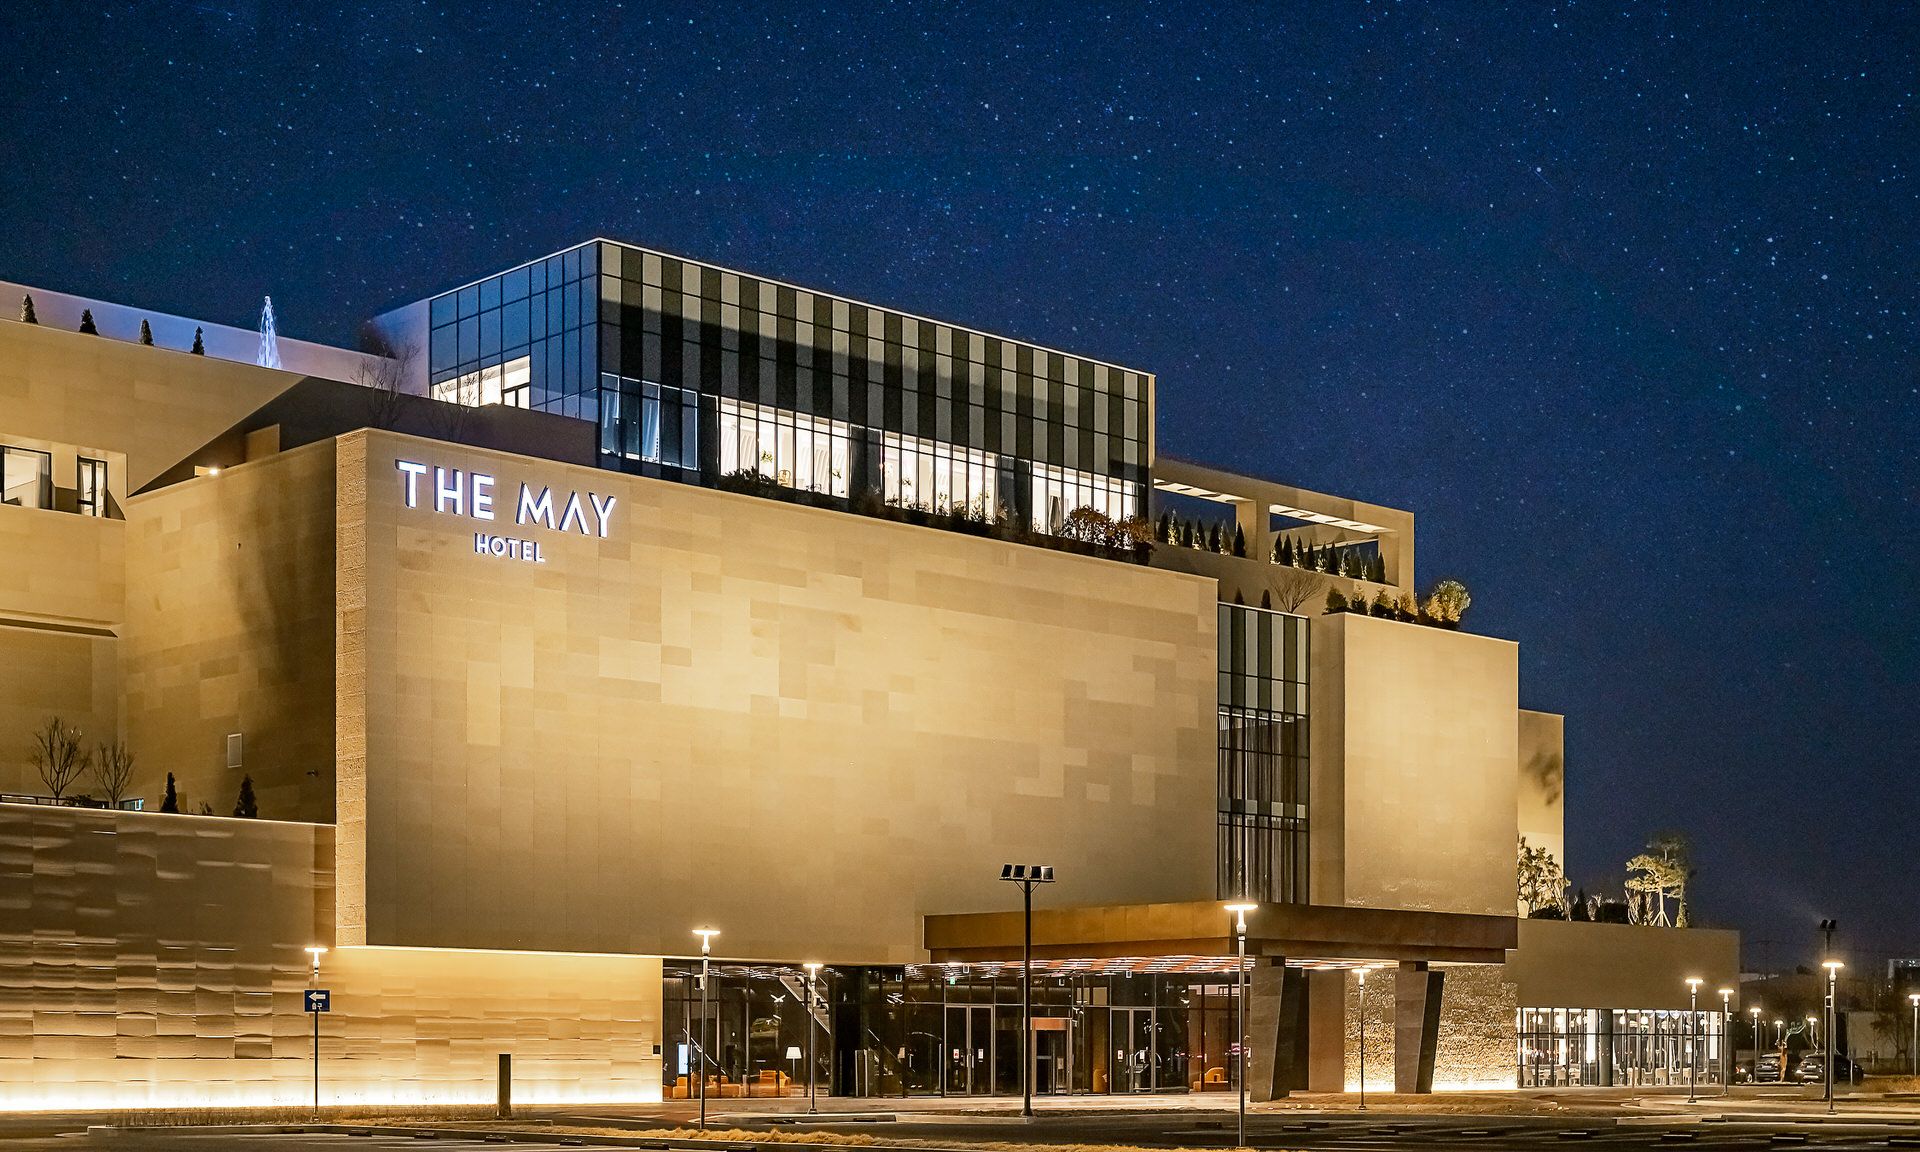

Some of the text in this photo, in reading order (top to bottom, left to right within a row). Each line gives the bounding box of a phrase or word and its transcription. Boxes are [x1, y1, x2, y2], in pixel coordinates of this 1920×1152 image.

[395, 459, 617, 538] THE MAY
[474, 532, 546, 563] HOTEL
